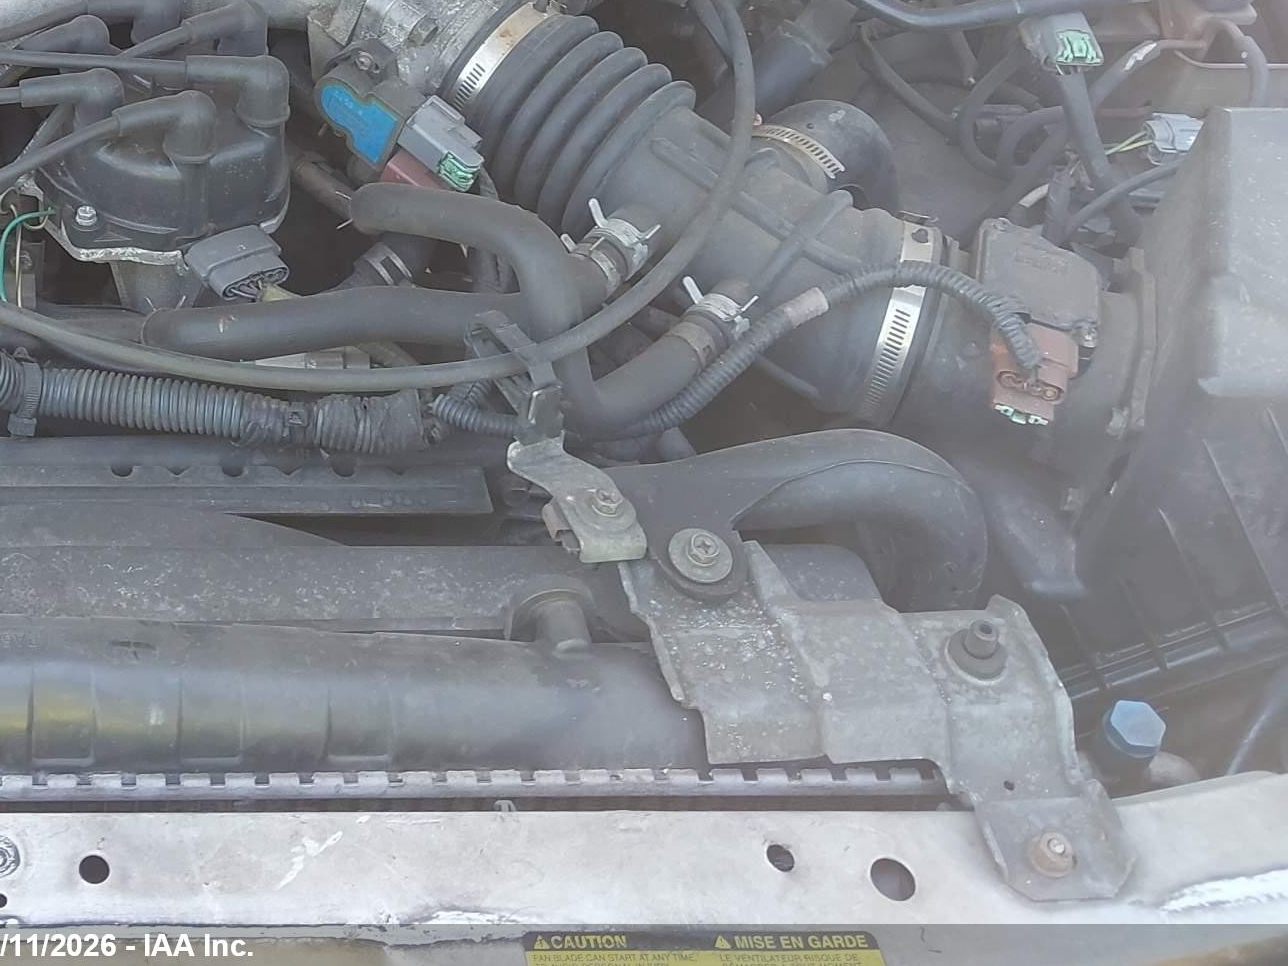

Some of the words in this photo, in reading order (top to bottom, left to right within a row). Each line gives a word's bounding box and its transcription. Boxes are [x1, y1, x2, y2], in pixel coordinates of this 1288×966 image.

[550, 935, 627, 949] CAUTION
[734, 935, 776, 949] MISE
[780, 935, 804, 949] EN
[808, 935, 869, 948] GARDE
[532, 954, 551, 962] FAN
[553, 954, 583, 962] BLADE
[585, 954, 606, 962] CAN
[611, 953, 637, 962] START
[639, 953, 652, 962] AT
[652, 953, 670, 962] ANY
[720, 953, 732, 962] LE
[735, 953, 801, 962] VENTILATEUR
[804, 953, 841, 962] RISQUE
[845, 953, 859, 961] DE
